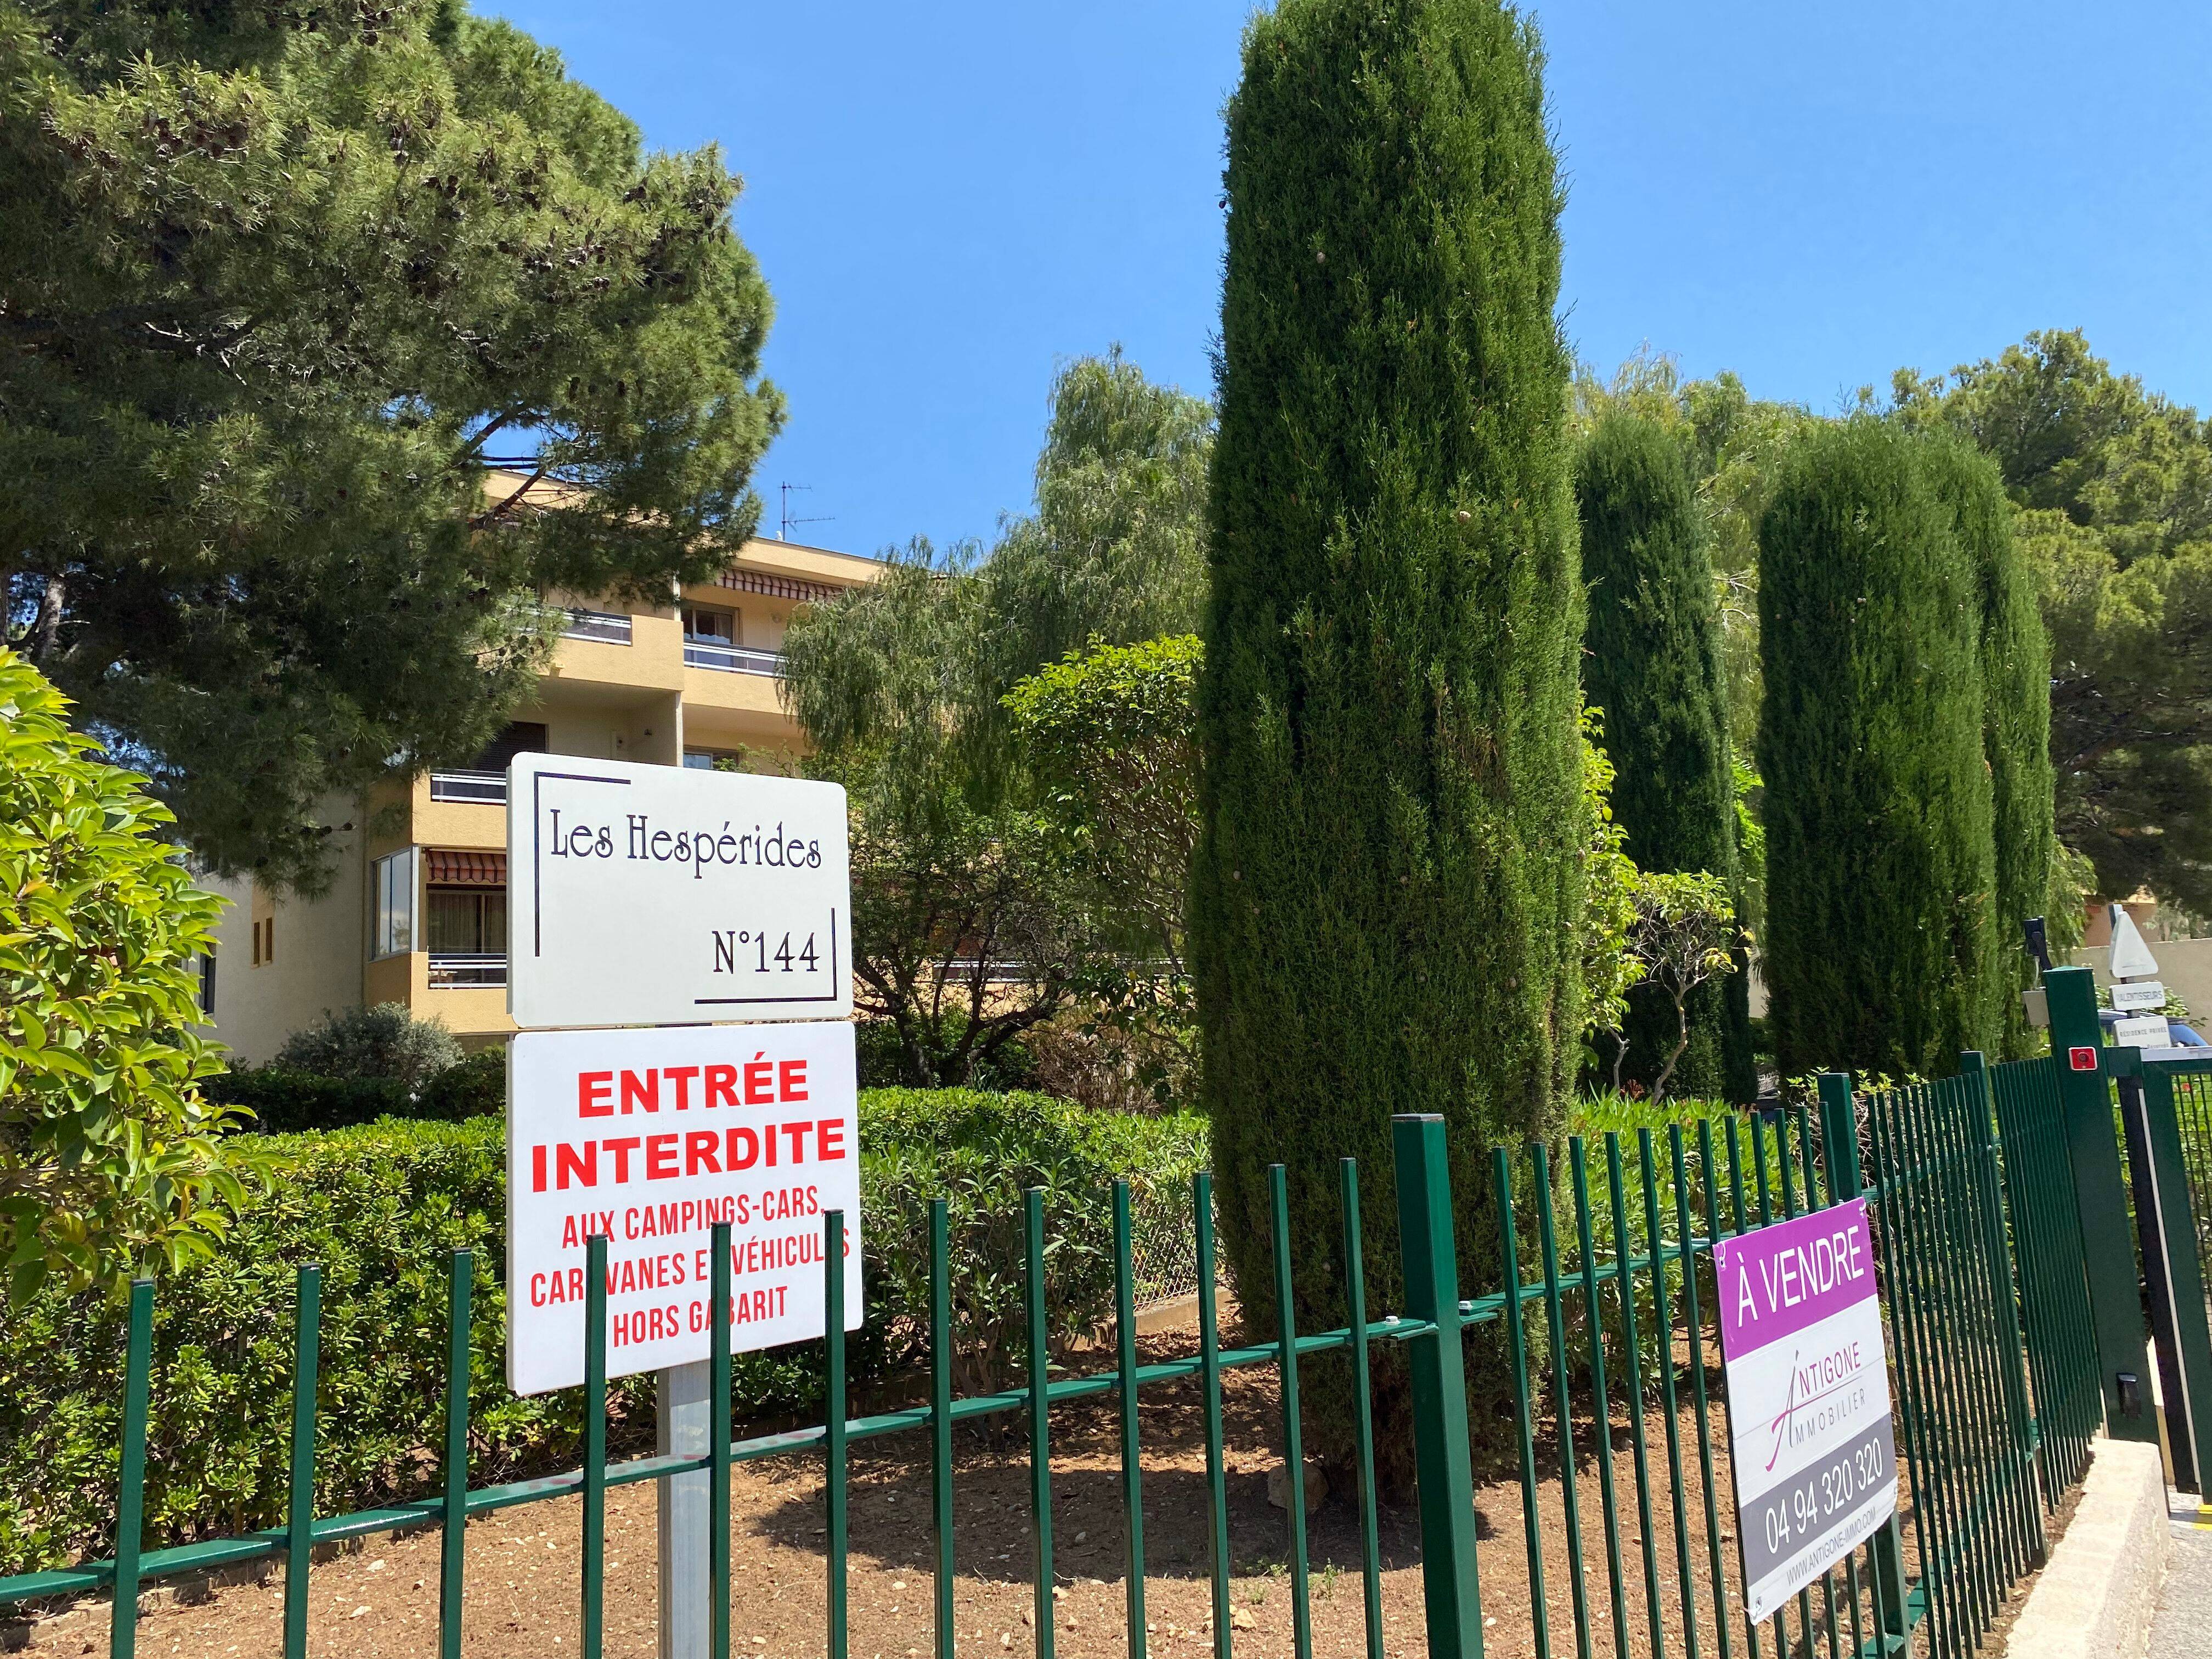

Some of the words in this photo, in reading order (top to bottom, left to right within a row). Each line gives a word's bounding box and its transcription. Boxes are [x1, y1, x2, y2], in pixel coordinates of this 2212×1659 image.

[550, 809, 613, 859] Les
[626, 814, 821, 879] Hespérides
[712, 930, 820, 974] N°144
[578, 1051, 809, 1118] ENTRÉE
[532, 1118, 846, 1193] INTERDITE
[562, 1210, 615, 1249] AUX
[531, 1252, 686, 1307] CARVANES
[695, 1249, 712, 1282] E
[730, 1228, 850, 1275] VÉHICULS
[1736, 1251, 1759, 1328] À
[1759, 1224, 1865, 1313] VENDRE
[613, 1305, 680, 1347] HORS
[1765, 1499, 1791, 1554] 04
[1794, 1481, 1818, 1534] 94
[1821, 1459, 1853, 1516] 320
[1855, 1437, 1883, 1491] 320
[1786, 1506, 1877, 1587] WWW.ANTIGONE-IMMO.COM
